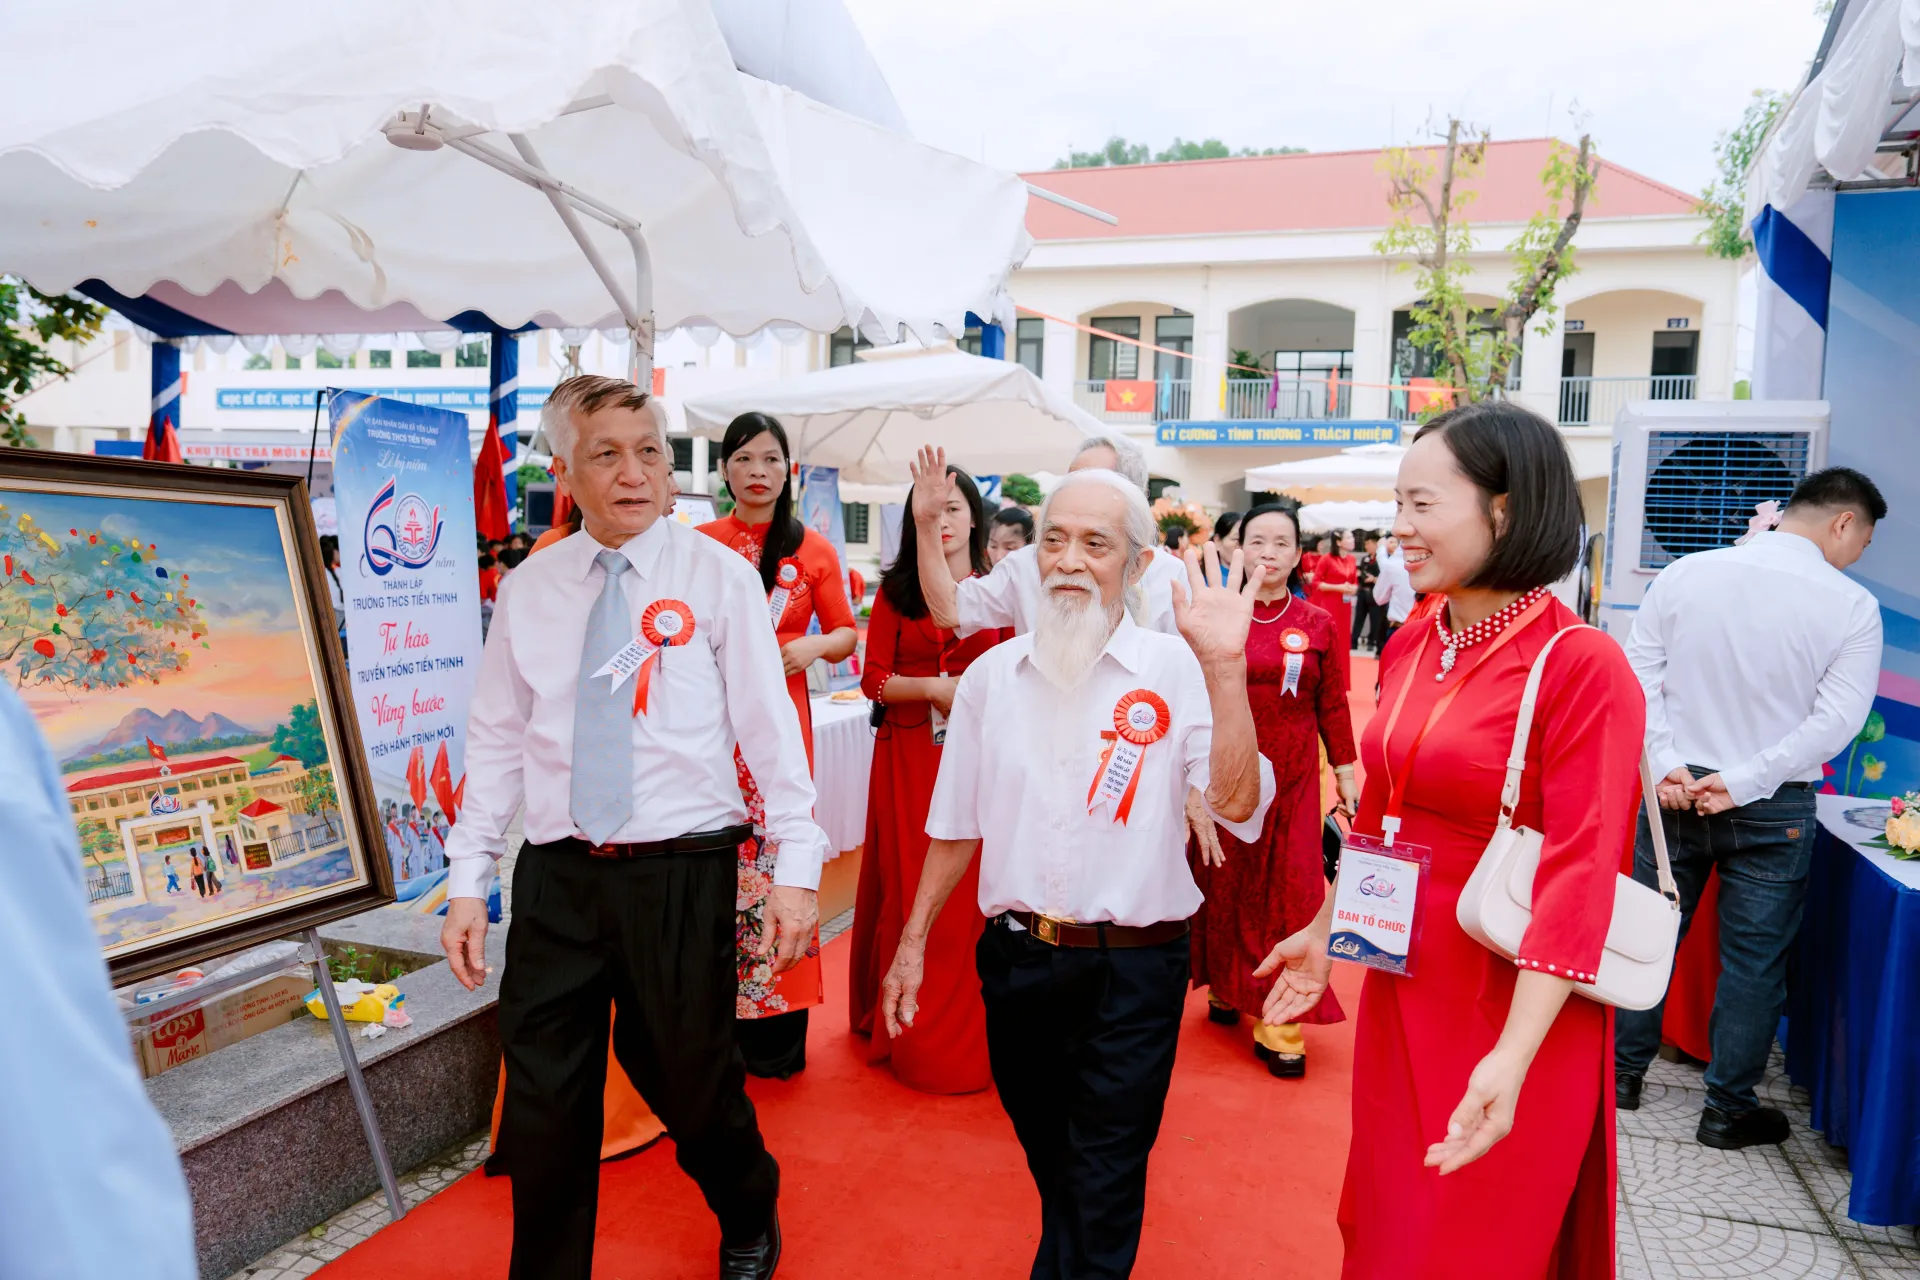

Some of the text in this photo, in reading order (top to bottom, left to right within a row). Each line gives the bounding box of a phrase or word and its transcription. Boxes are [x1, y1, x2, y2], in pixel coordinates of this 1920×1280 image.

[222, 394, 241, 407] HỌC
[281, 394, 300, 407] HỌC
[368, 428, 390, 440] TRƯỜNG
[392, 432, 408, 442] THCS
[1162, 424, 1176, 440] KỶ
[1179, 428, 1217, 440] CƯƠNG
[1227, 426, 1254, 440] TÌNH
[1256, 427, 1302, 440] THƯƠNG
[1312, 426, 1350, 440] TRÁCH
[1353, 426, 1393, 444] NHIỆM
[186, 446, 210, 456] KHU
[214, 444, 241, 458] TIỆC
[383, 577, 424, 590] THÀNH LẬP
[353, 589, 458, 610] TRƯỜNG THCS TIẾN THỊNH
[379, 621, 431, 656] Tự hào
[358, 655, 464, 684] TRUYỀN THỐNG TIẾN THỊNH
[372, 688, 445, 736] Vững bước
[371, 724, 454, 760] TRÊN HÀNH TRÌNH MỚI
[1338, 909, 1406, 934] BAN TỔ CHỨC
[155, 1010, 198, 1042] COSY
[168, 1044, 200, 1067] Marie
